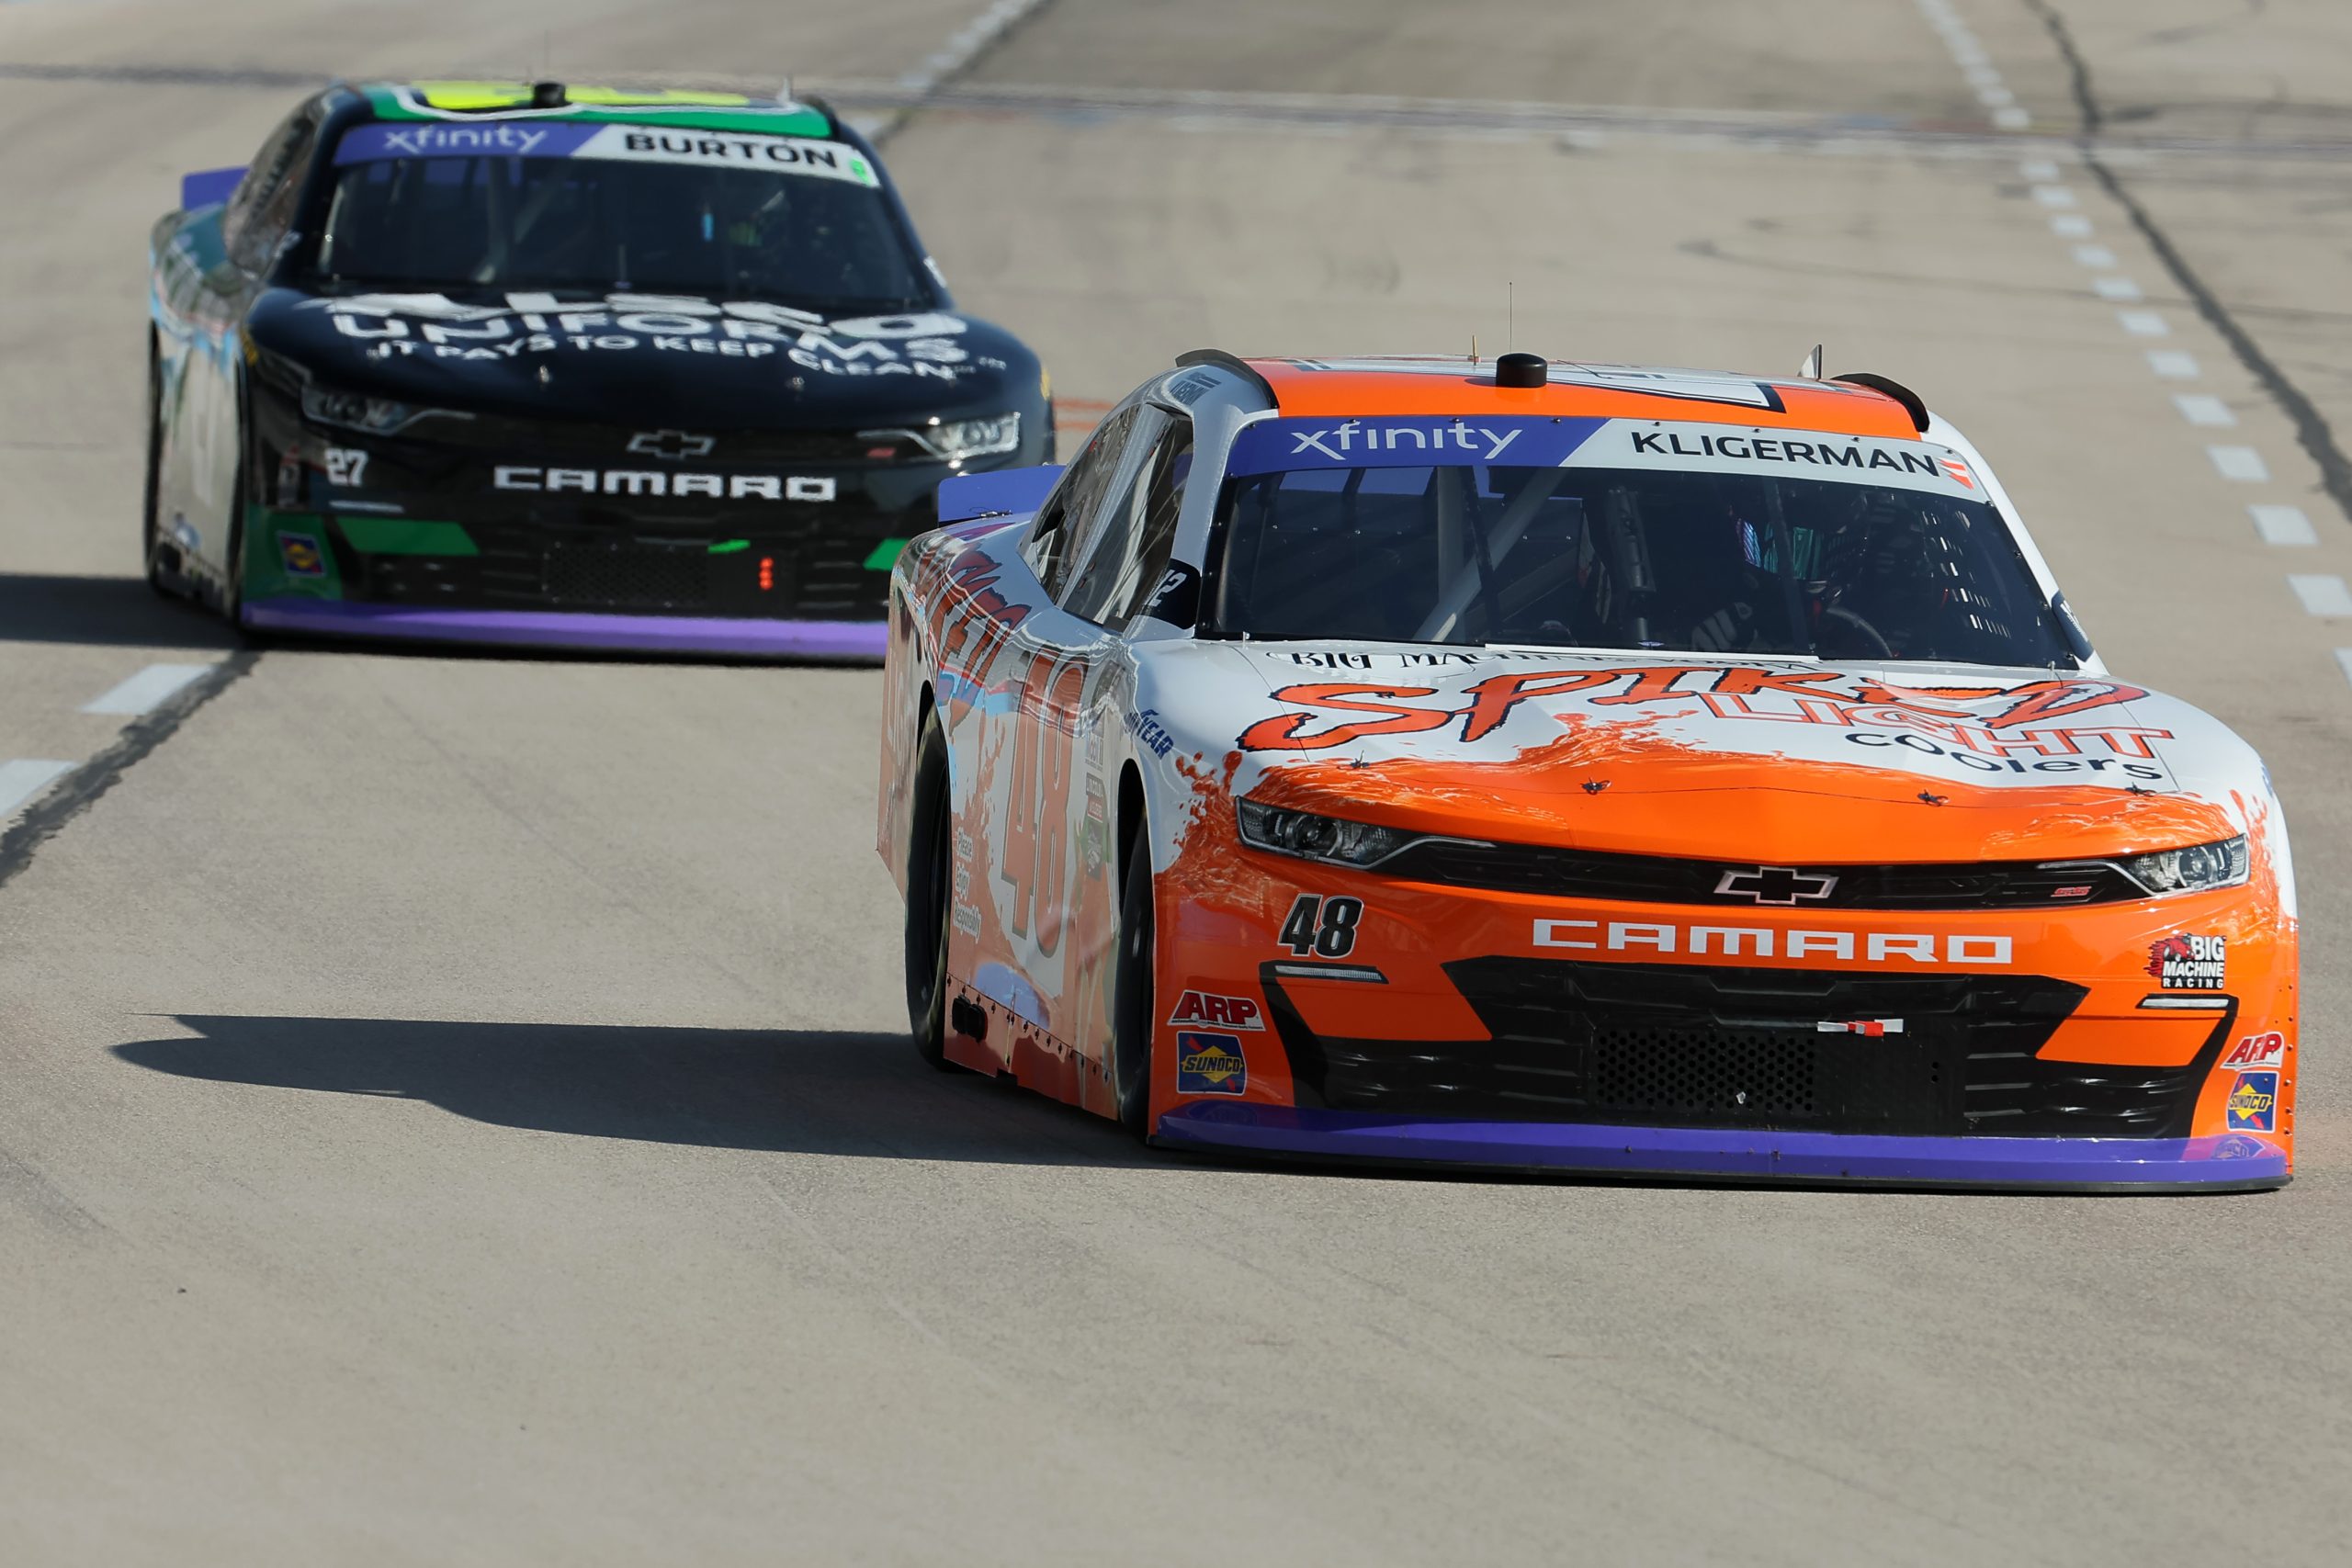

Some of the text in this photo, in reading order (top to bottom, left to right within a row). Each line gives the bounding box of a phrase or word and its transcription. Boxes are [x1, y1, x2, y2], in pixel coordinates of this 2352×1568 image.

[383, 124, 548, 154] xfinity
[625, 131, 838, 168] BURTON
[332, 313, 969, 363] UNIFORMS
[435, 333, 557, 361] PAYS
[567, 334, 639, 351] TO
[652, 335, 776, 357] KEEP
[787, 347, 957, 381] CLEAN
[1291, 420, 1523, 460] xfinity
[1630, 431, 1940, 478] KLIGERMAN
[324, 447, 368, 486] 27
[493, 465, 837, 502] CAMARO
[1701, 692, 2176, 759] LIGHT
[1845, 732, 2164, 781] coolers
[1277, 893, 1365, 960] 48
[1532, 918, 2012, 964] CAMARO
[2190, 935, 2225, 961] BIG
[2163, 961, 2224, 977] MACHINE
[2163, 977, 2224, 989] RACING
[1172, 991, 1260, 1026] ARP
[1183, 1055, 1241, 1074] SUNOCO
[2229, 1094, 2271, 1111] SUNOCO
